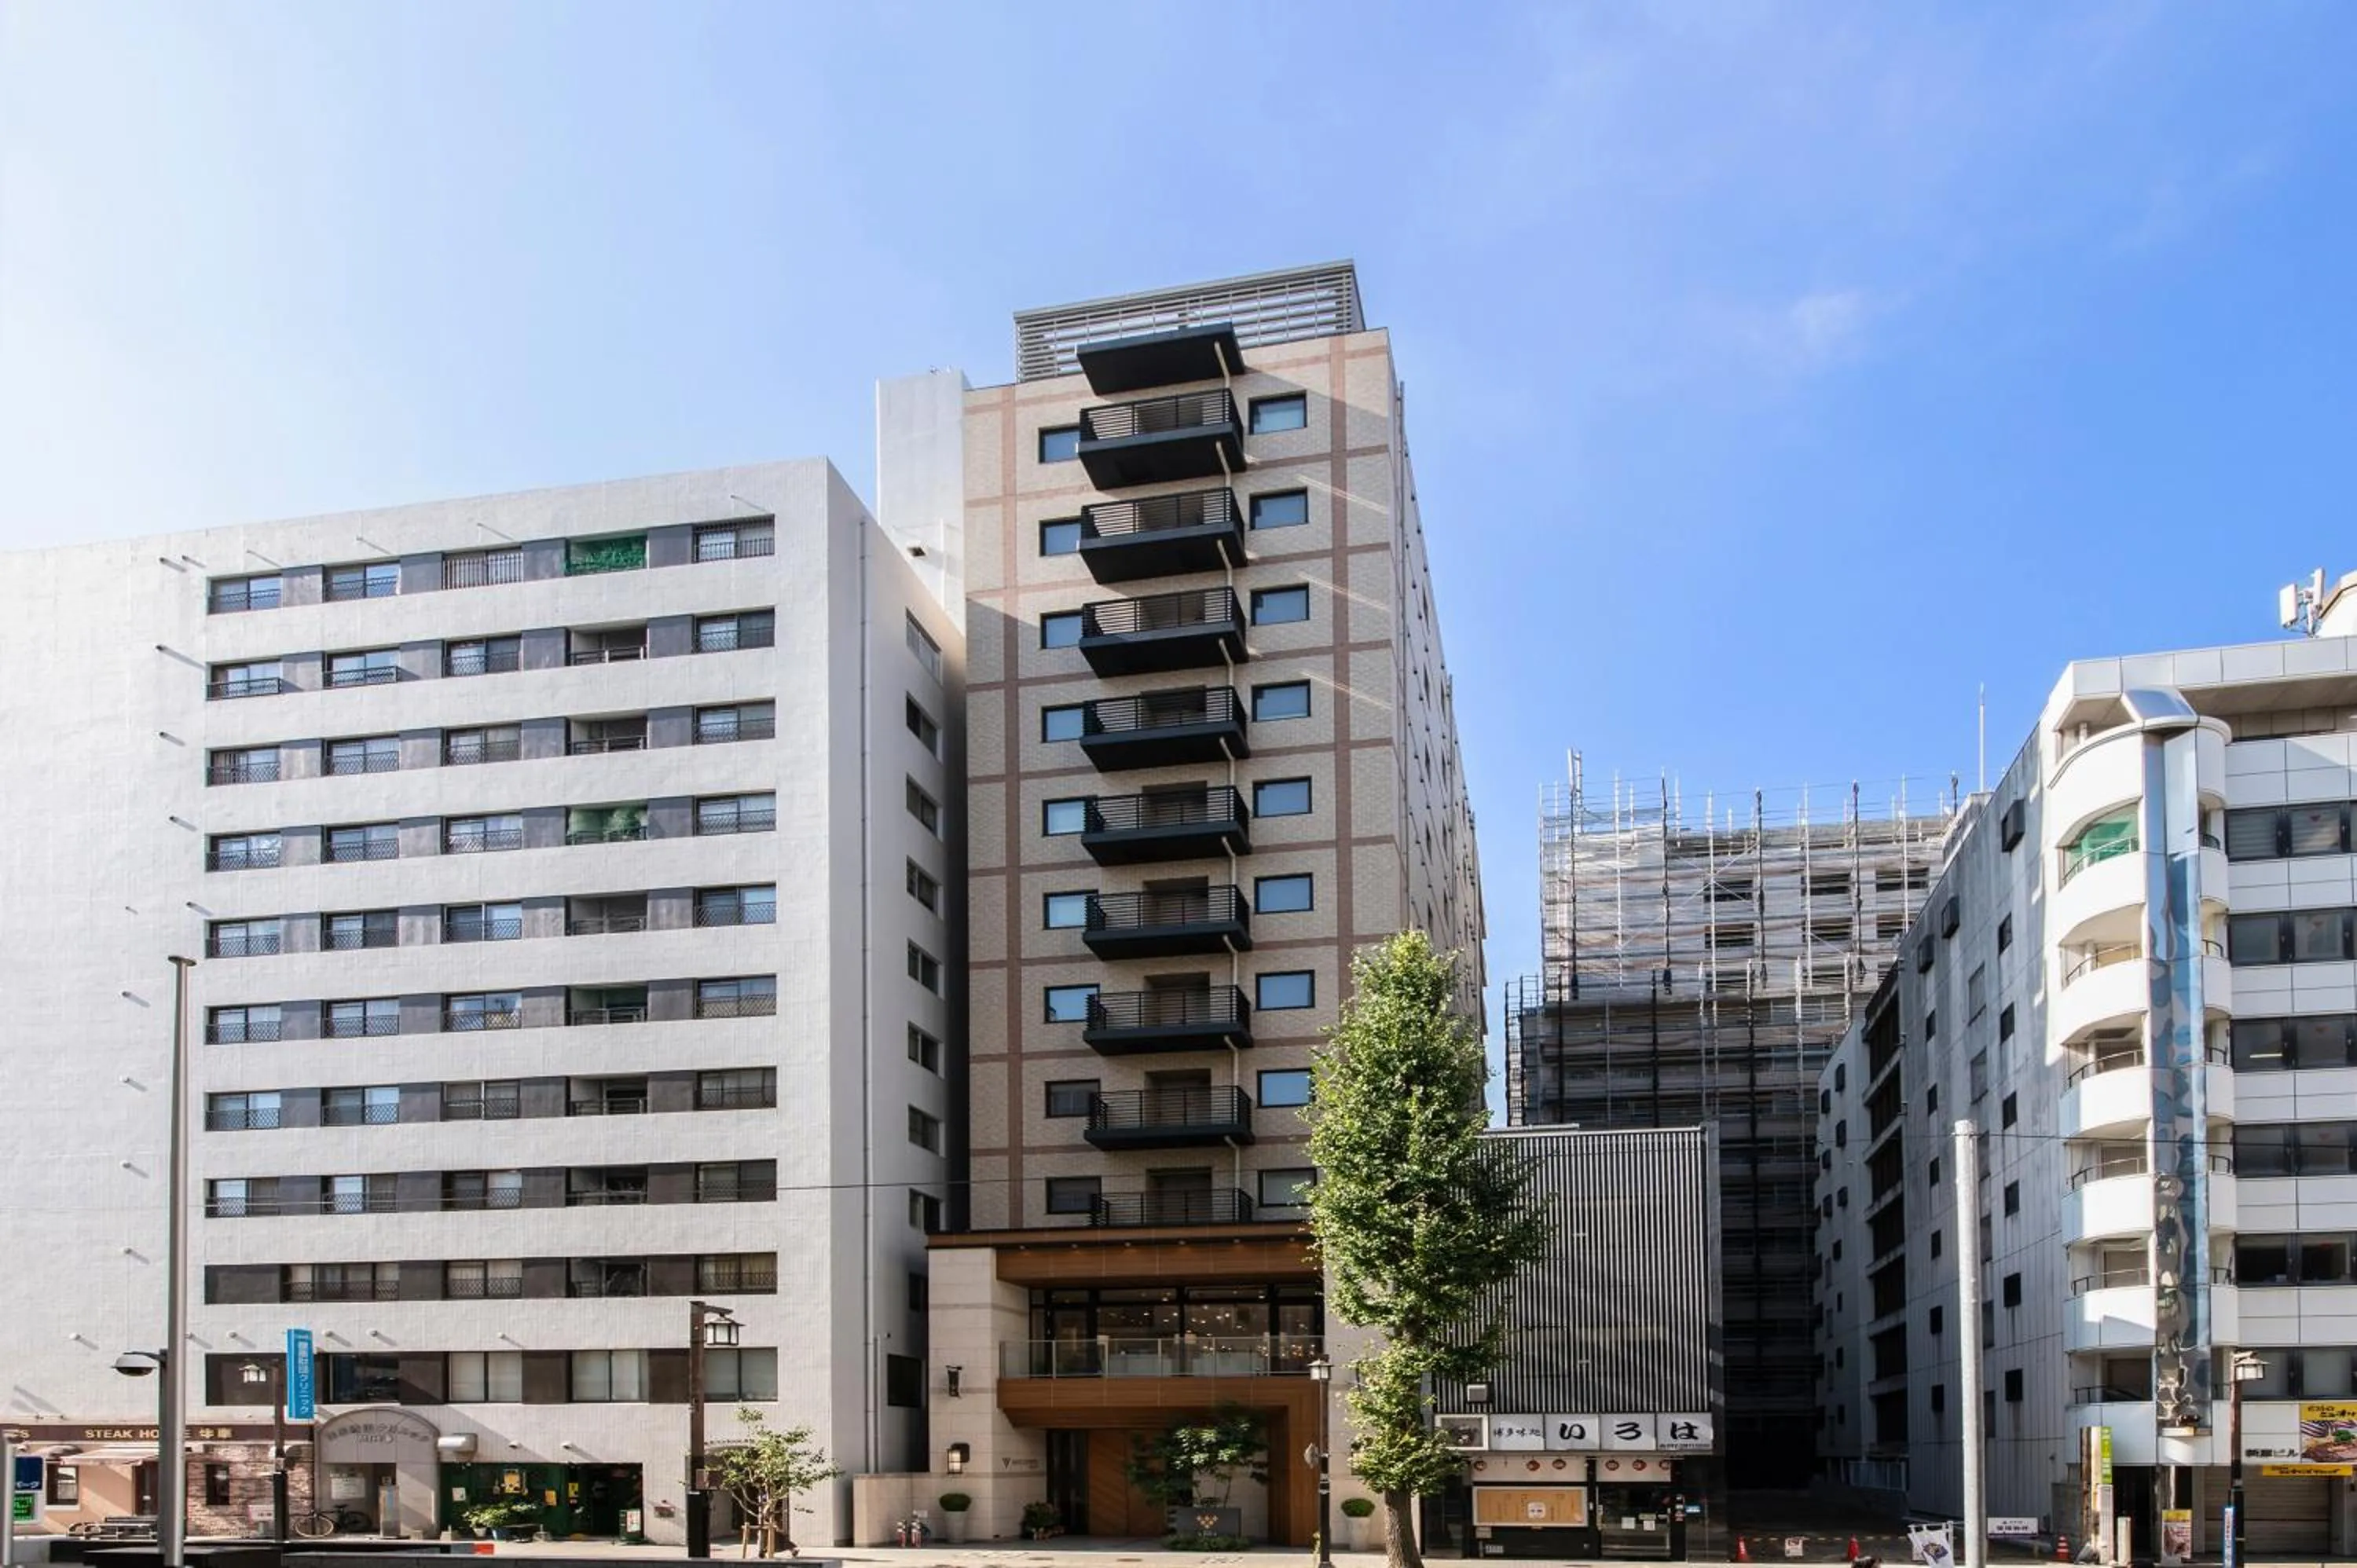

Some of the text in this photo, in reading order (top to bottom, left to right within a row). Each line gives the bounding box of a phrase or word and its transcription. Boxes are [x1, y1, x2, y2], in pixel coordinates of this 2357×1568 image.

[85, 1429, 133, 1439] STEAK
[138, 1429, 192, 1439] HOE
[1558, 1421, 1699, 1442] いろは
